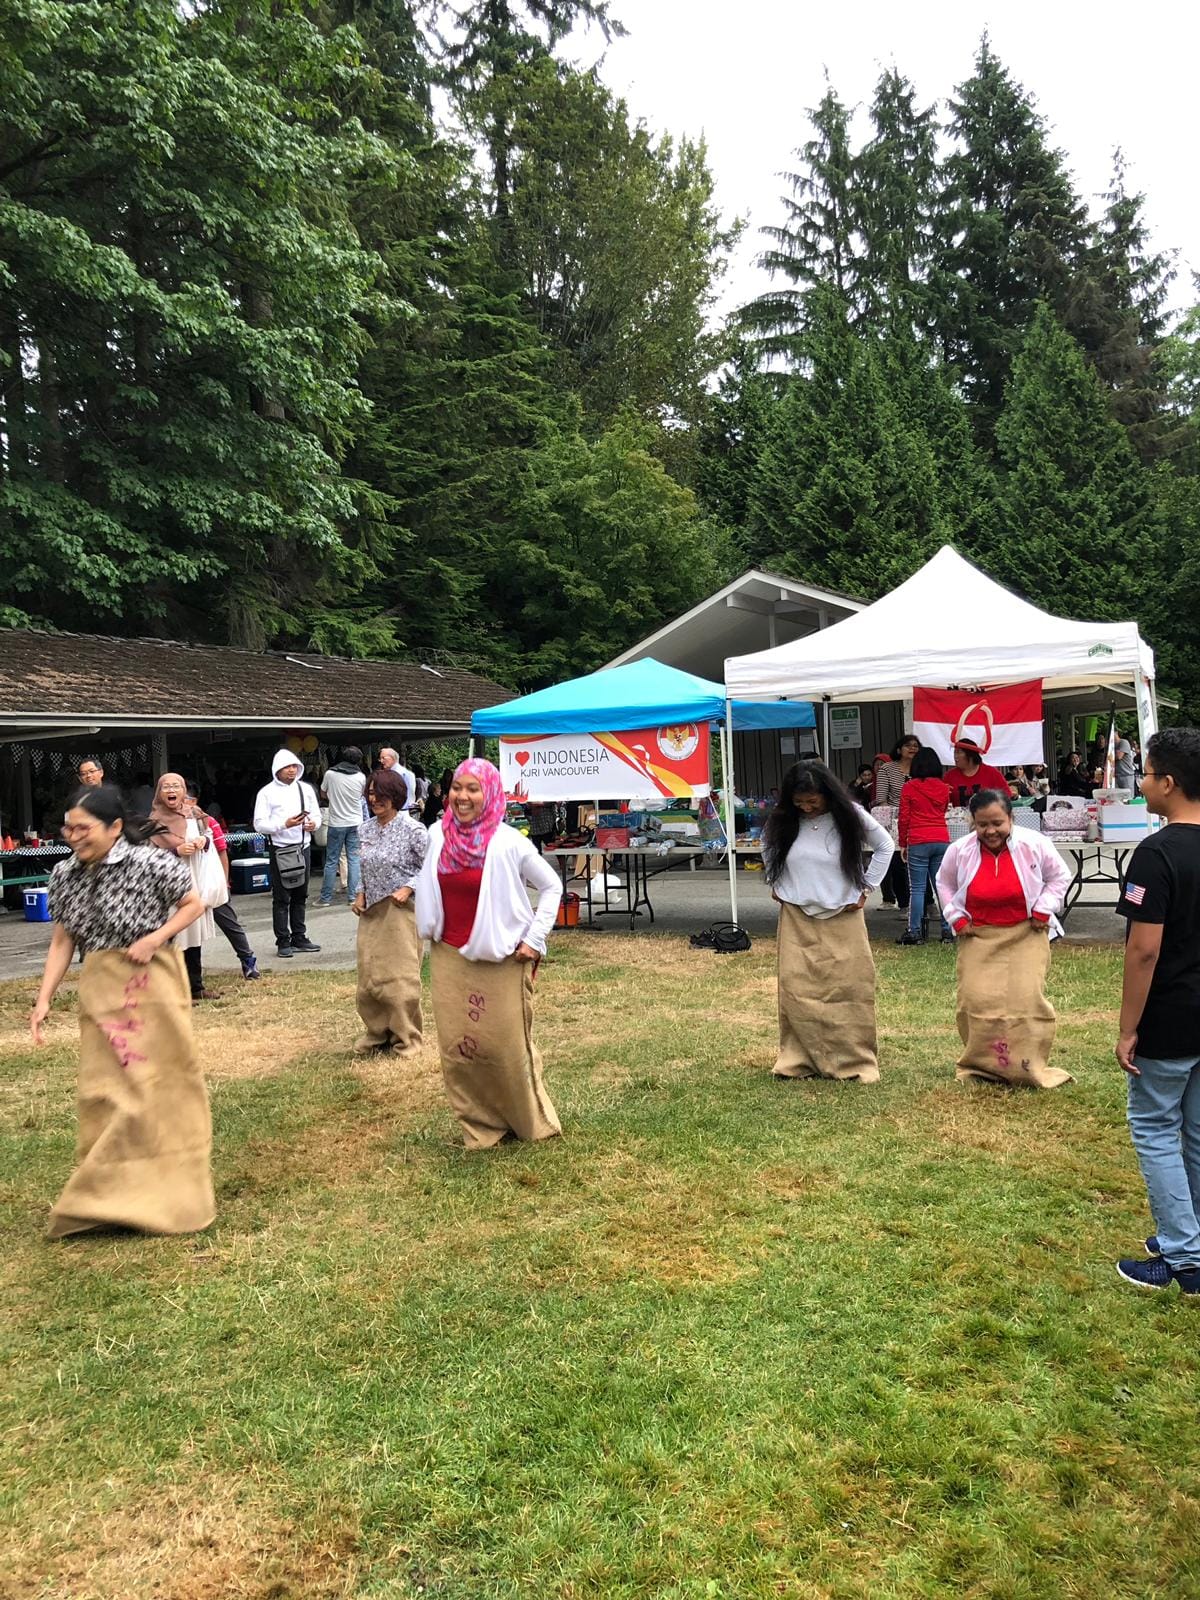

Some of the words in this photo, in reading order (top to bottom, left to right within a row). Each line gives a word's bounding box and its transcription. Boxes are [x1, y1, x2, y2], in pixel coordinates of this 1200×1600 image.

[508, 751, 512, 765] I
[533, 748, 610, 765] INDONESIA
[520, 768, 540, 777] KJRI
[542, 766, 600, 776] VANCOUVER
